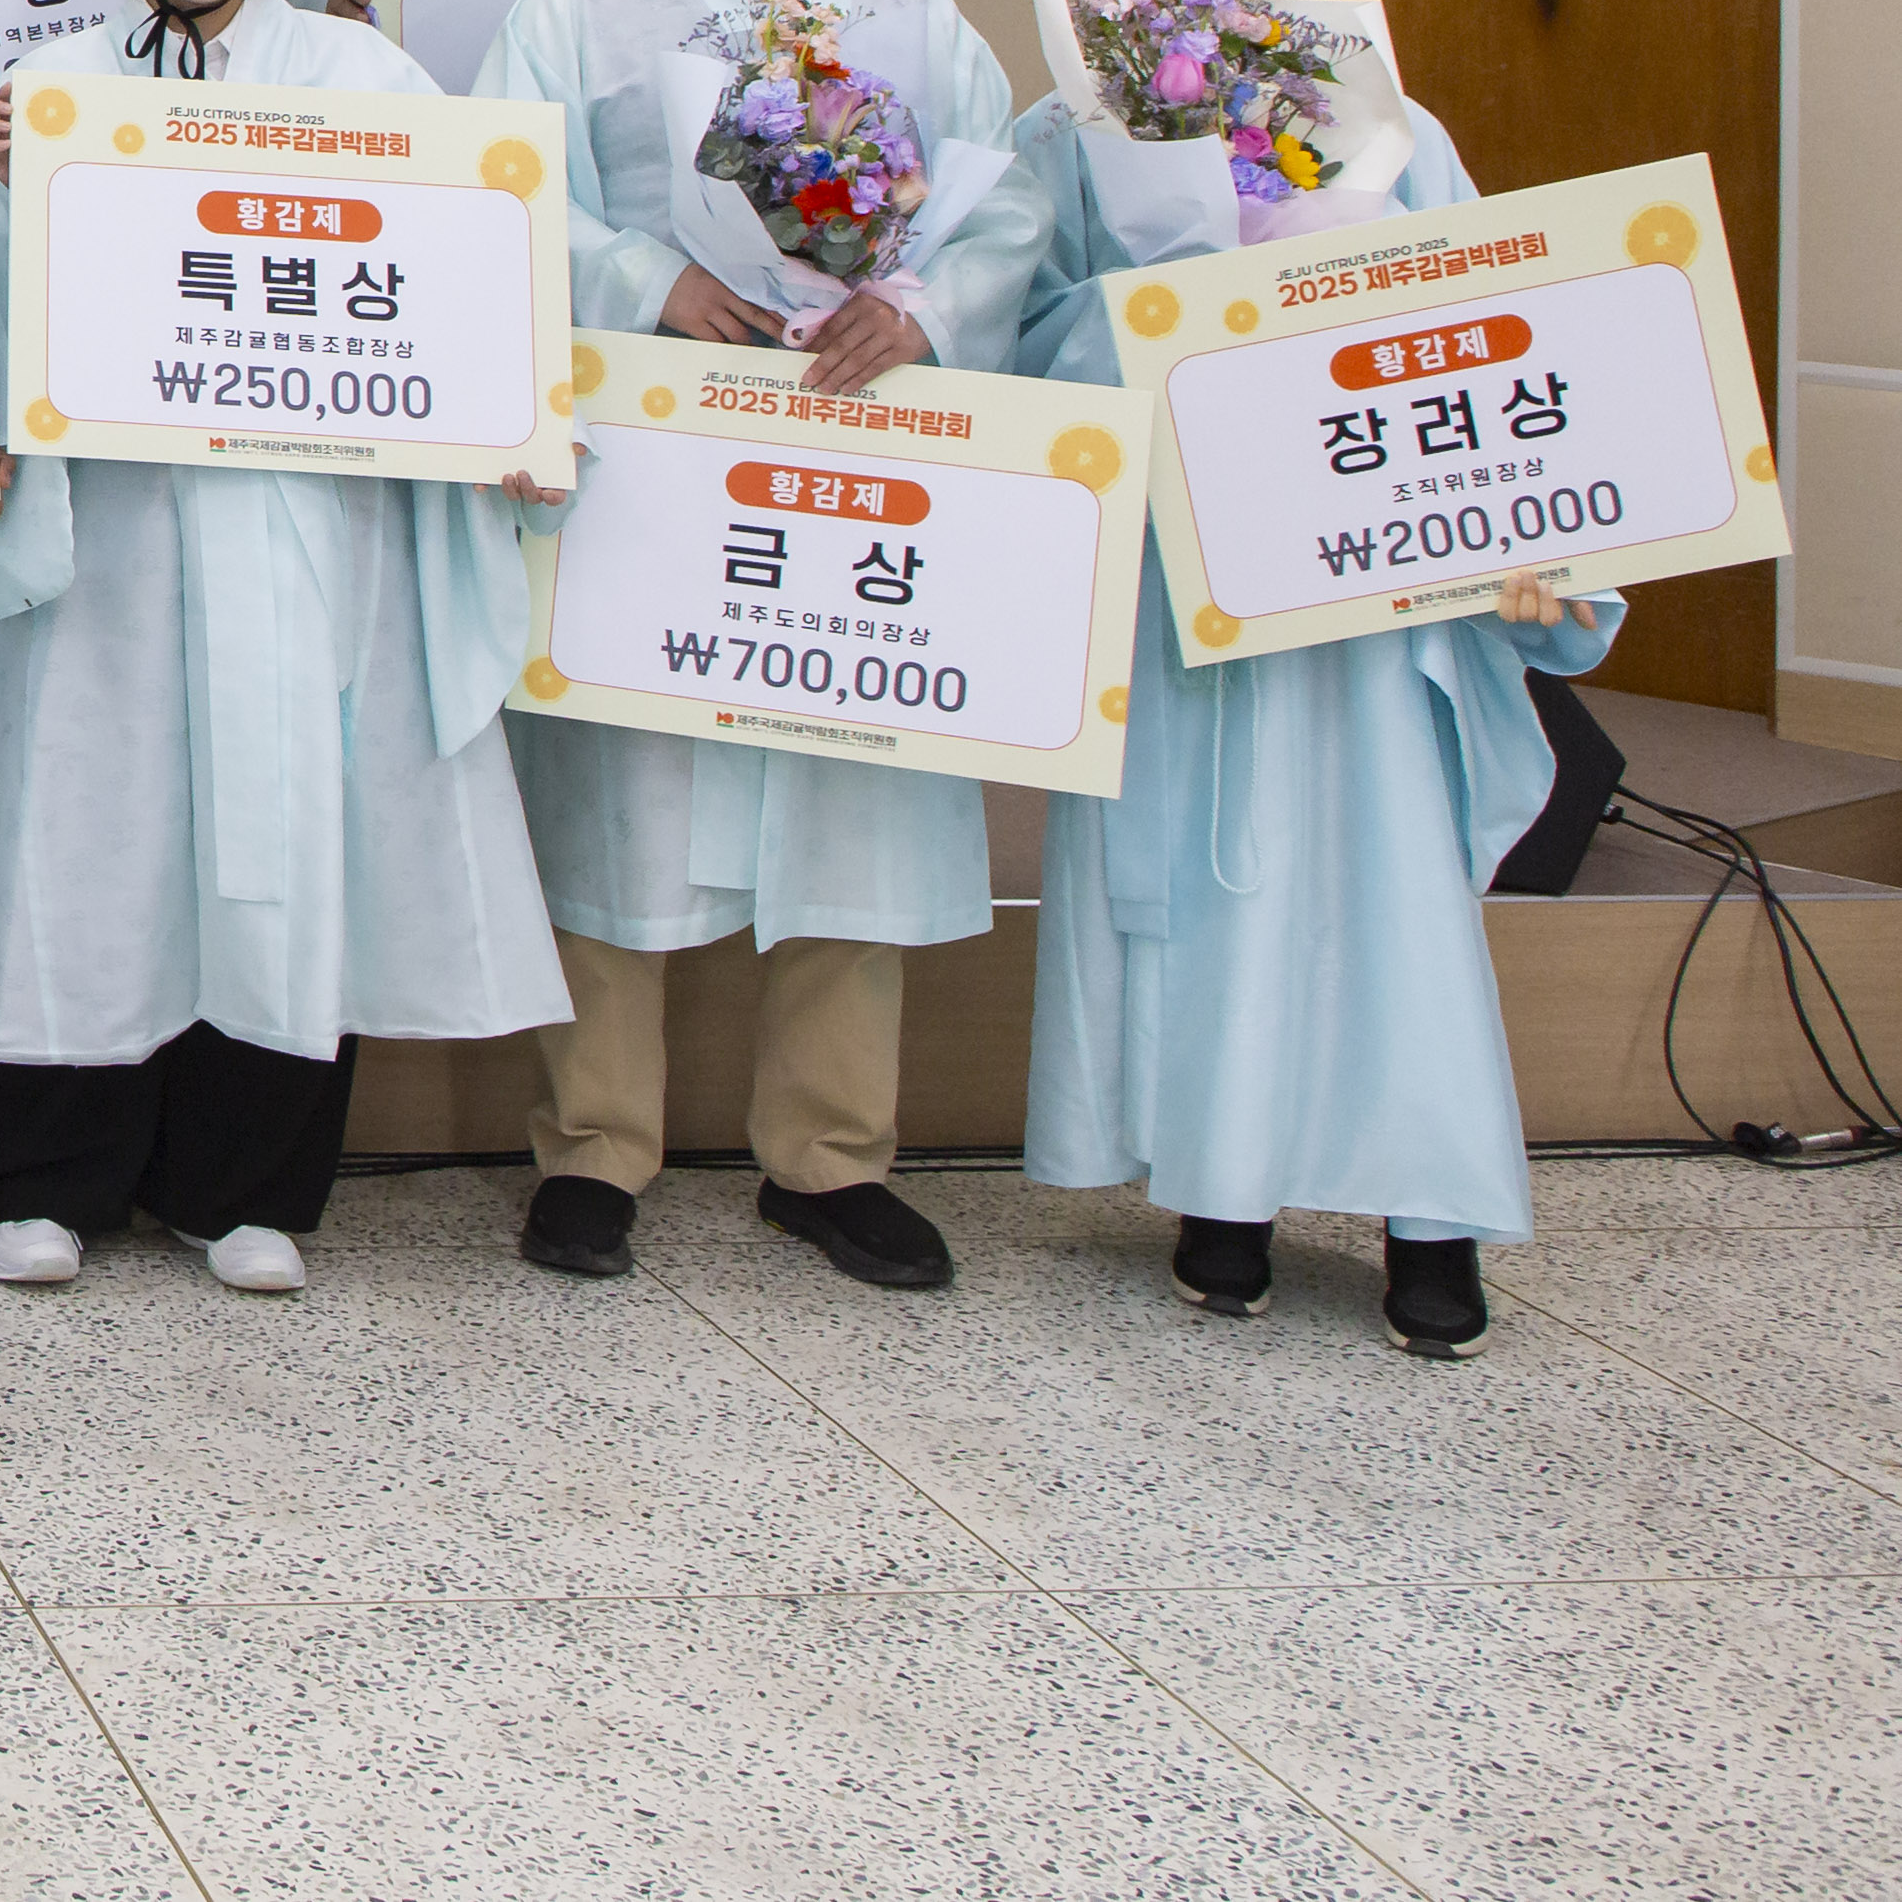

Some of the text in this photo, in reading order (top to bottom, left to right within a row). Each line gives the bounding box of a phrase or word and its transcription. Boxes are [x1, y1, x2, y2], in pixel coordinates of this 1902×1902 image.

[166, 106, 325, 125] JEJU CITRUS EXPO 2025
[166, 120, 411, 158] 2025 제주감귤박람회
[236, 198, 342, 235] 황감제
[1275, 237, 1449, 282] JEJU CITRUS EXPO 2025
[1277, 231, 1549, 308] 2025 제주감귤박람회
[177, 249, 405, 322] 특별상
[175, 326, 414, 359] 제주감귤협동조합장상
[1371, 326, 1490, 380] 황감제
[701, 371, 738, 385] JEJU
[742, 376, 795, 391] CITRUS
[843, 388, 878, 400] 025
[699, 385, 972, 440] 2025 제주감귤박람회
[1319, 371, 1569, 476] 장려상
[769, 470, 885, 516] 황감제
[1391, 457, 1545, 503] 조직위원장상
[722, 601, 931, 647] 제주도의회의장상
